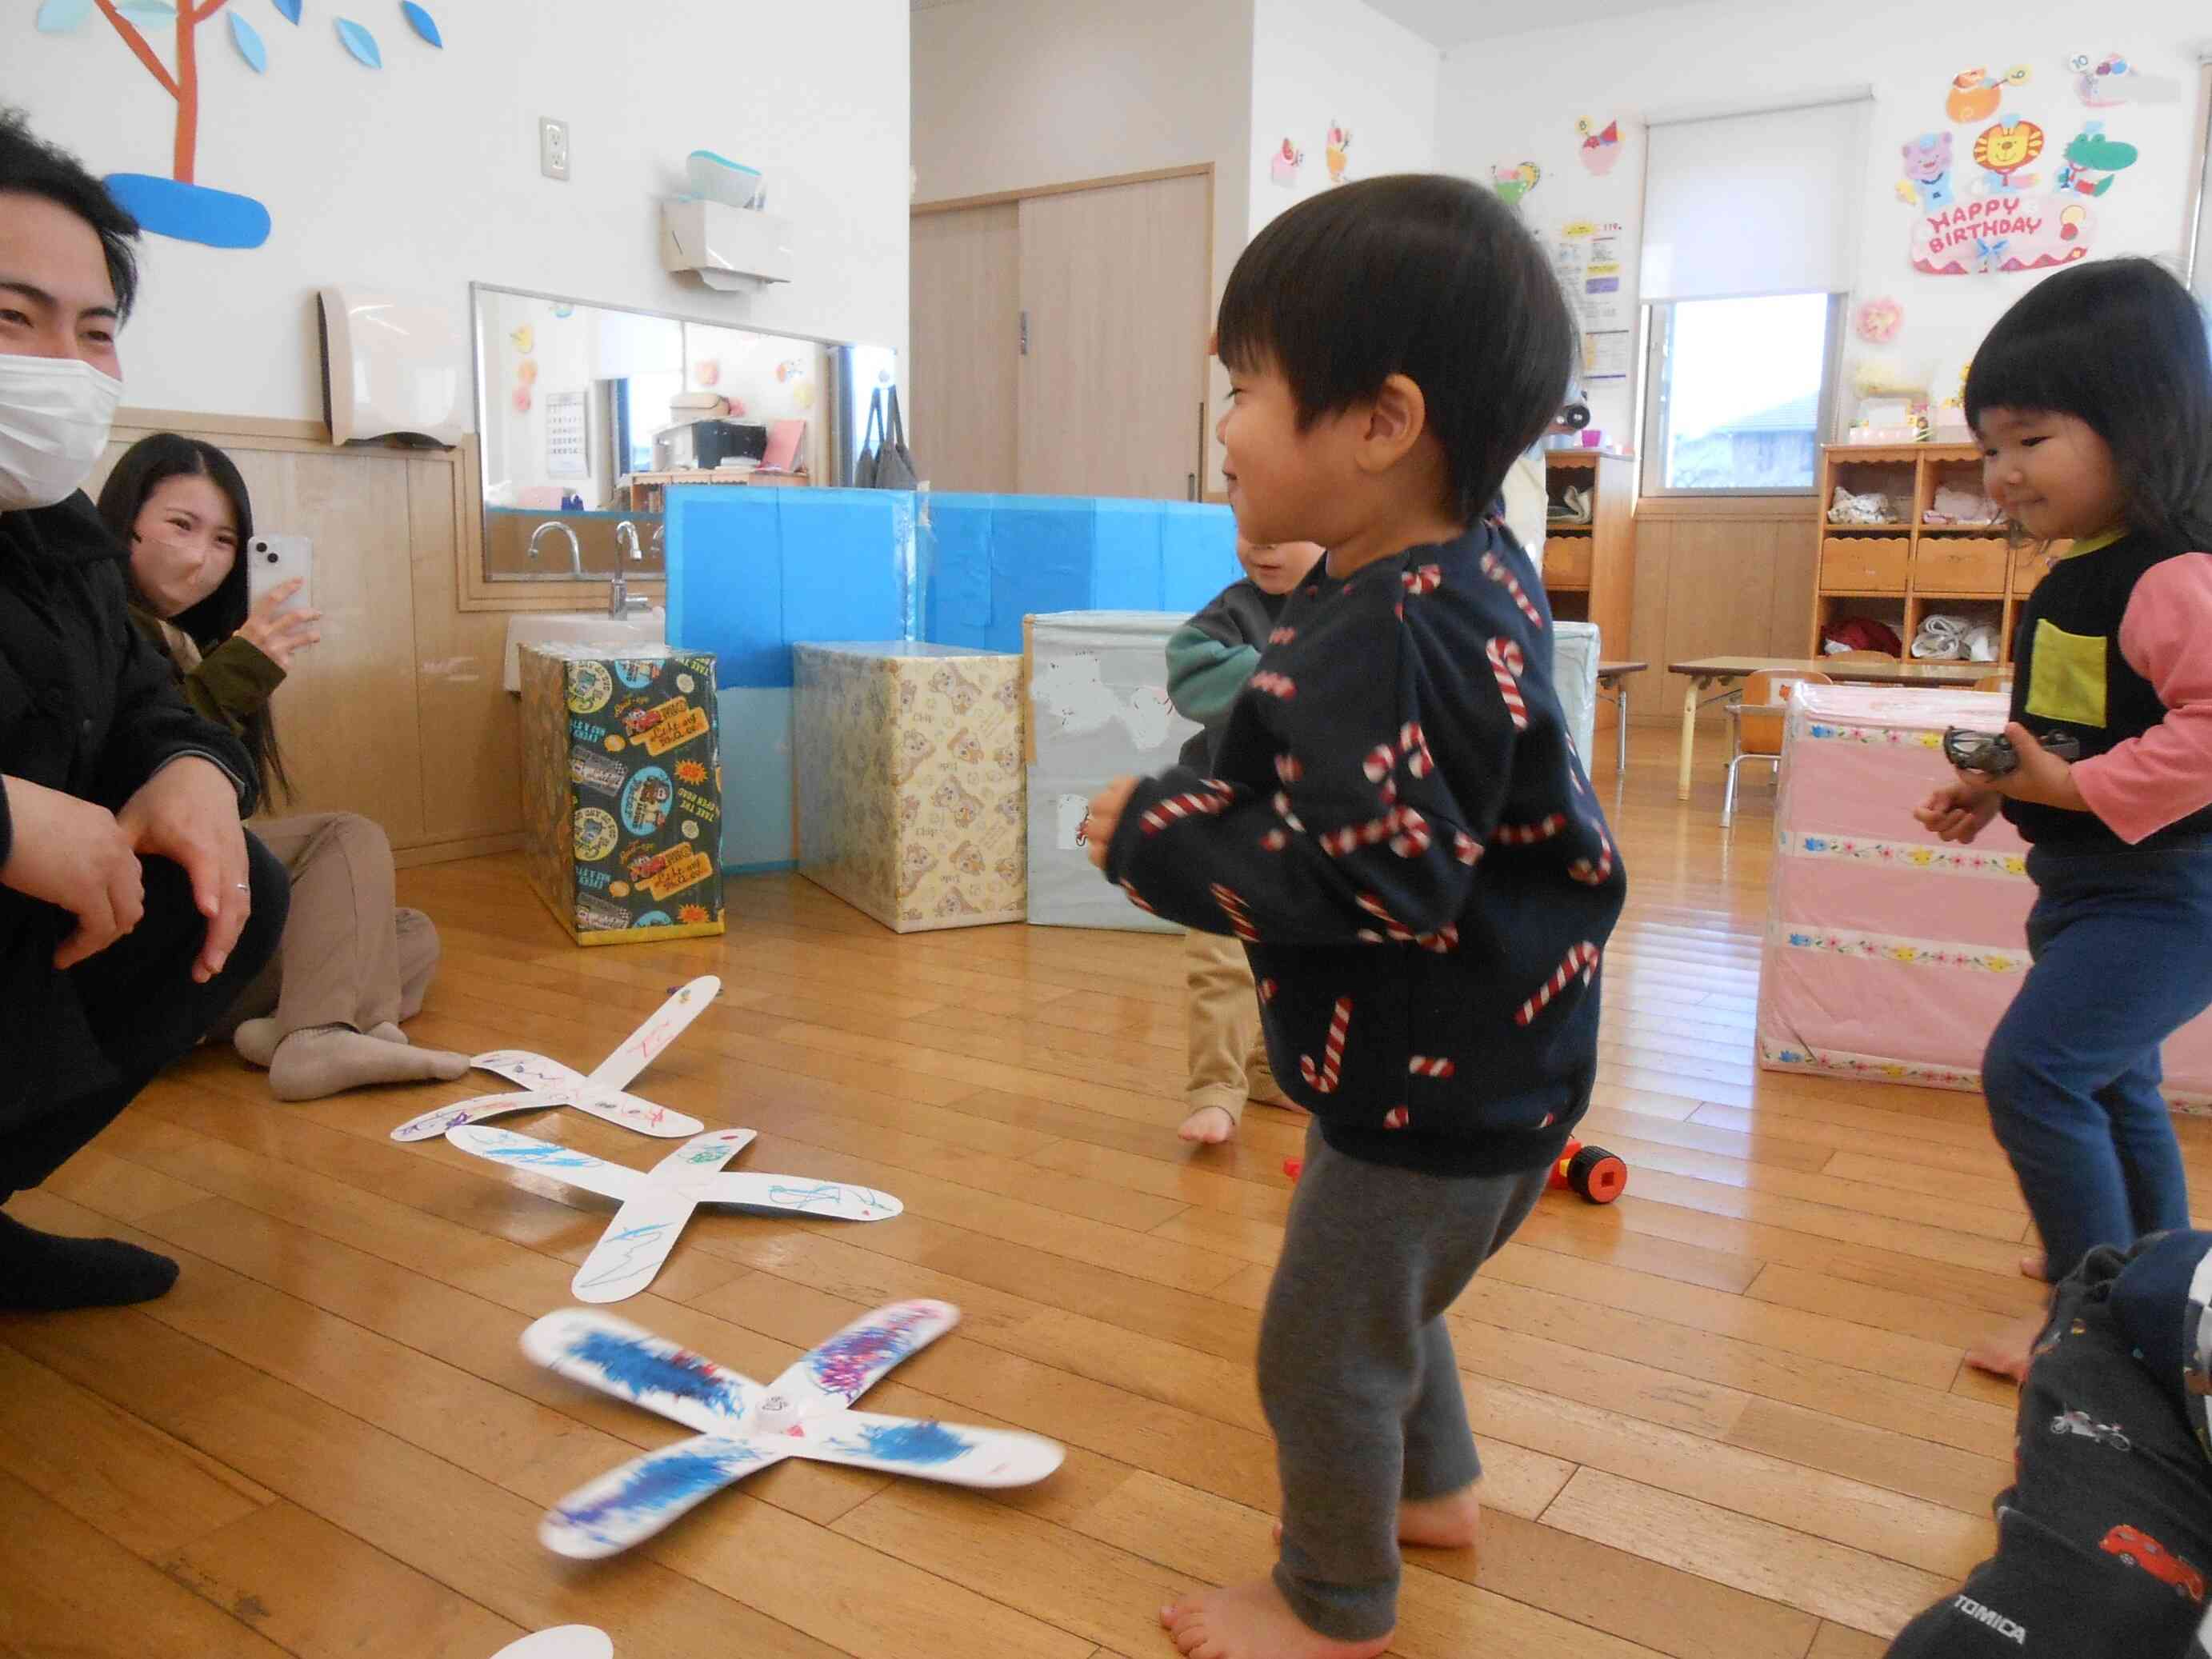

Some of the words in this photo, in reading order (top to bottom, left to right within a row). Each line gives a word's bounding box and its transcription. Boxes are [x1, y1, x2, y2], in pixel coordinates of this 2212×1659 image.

[1926, 198, 2021, 234] HAPPY
[1929, 216, 2042, 254] BIRTHDAY
[1954, 1593, 2026, 1645] TOMICA
